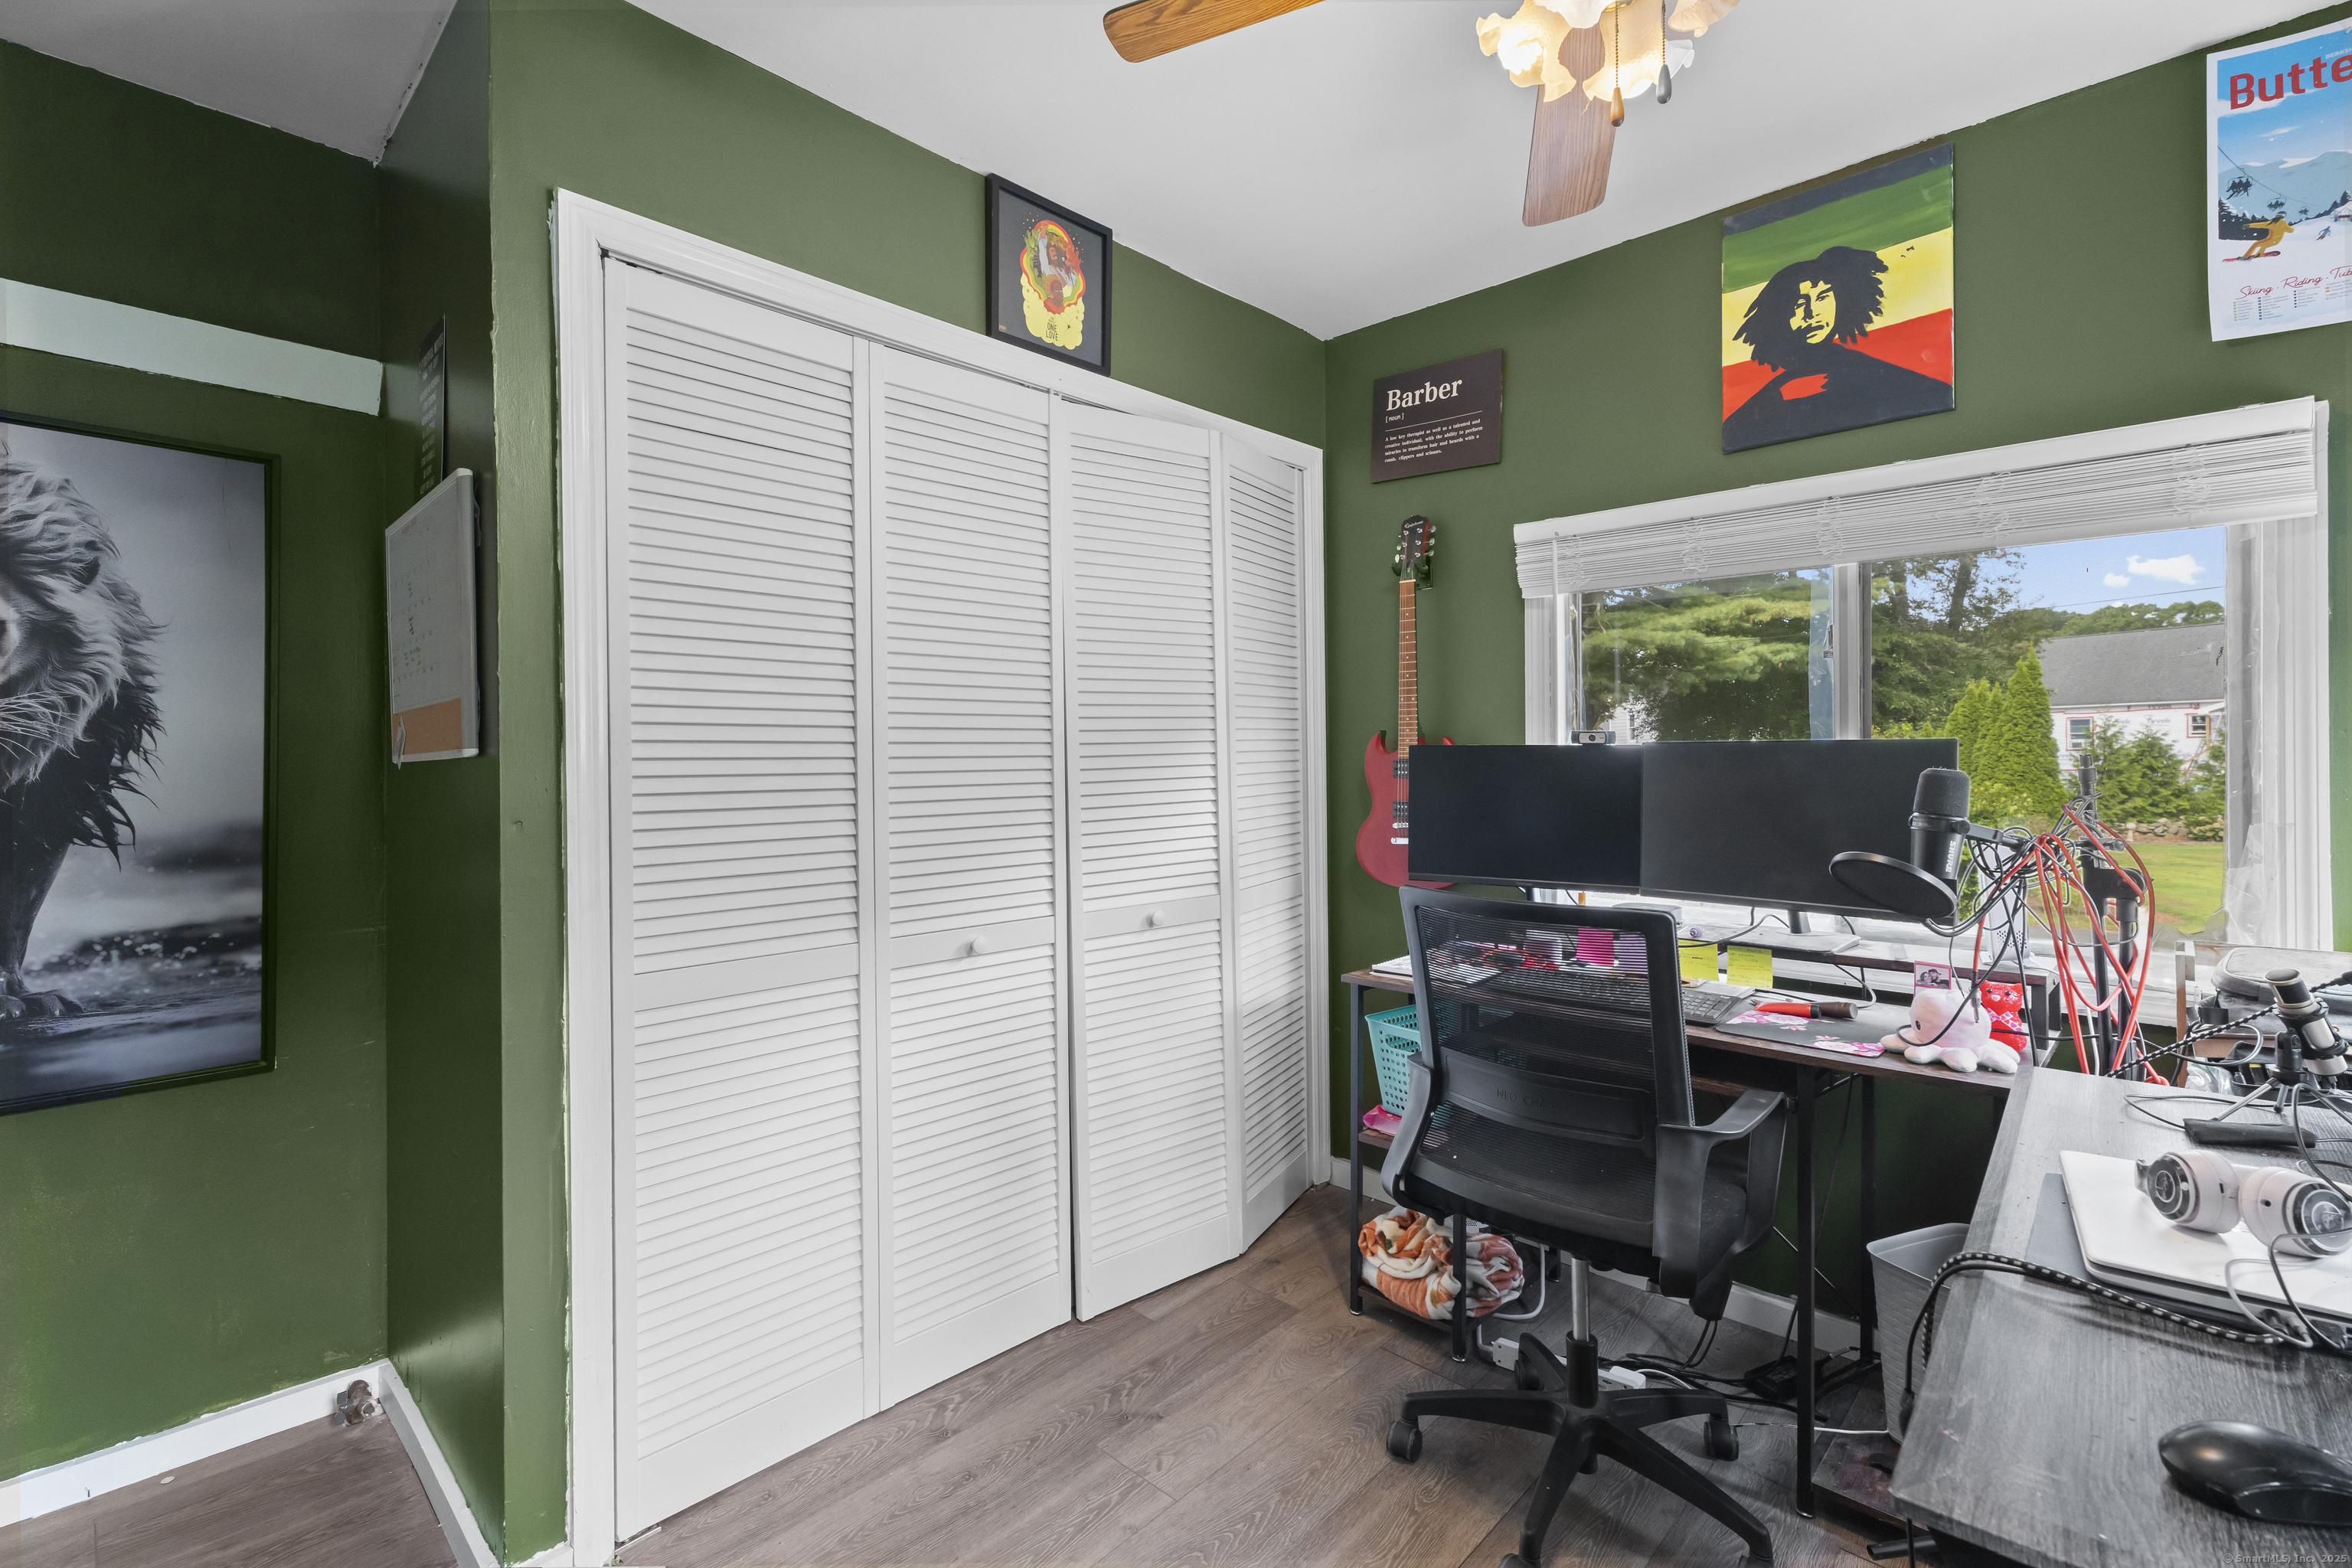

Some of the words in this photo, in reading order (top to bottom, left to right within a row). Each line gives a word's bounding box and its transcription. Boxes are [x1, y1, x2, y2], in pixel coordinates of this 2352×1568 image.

[2230, 54, 2352, 110] Butte
[2235, 286, 2274, 299] Skiing
[2281, 276, 2323, 288] Riding
[1046, 330, 1058, 341] LOVE
[1047, 322, 1057, 332] ONE
[1386, 380, 1462, 411] Barber
[1945, 841, 1956, 873] SHURE
[1524, 1096, 1559, 1110] CHAIR
